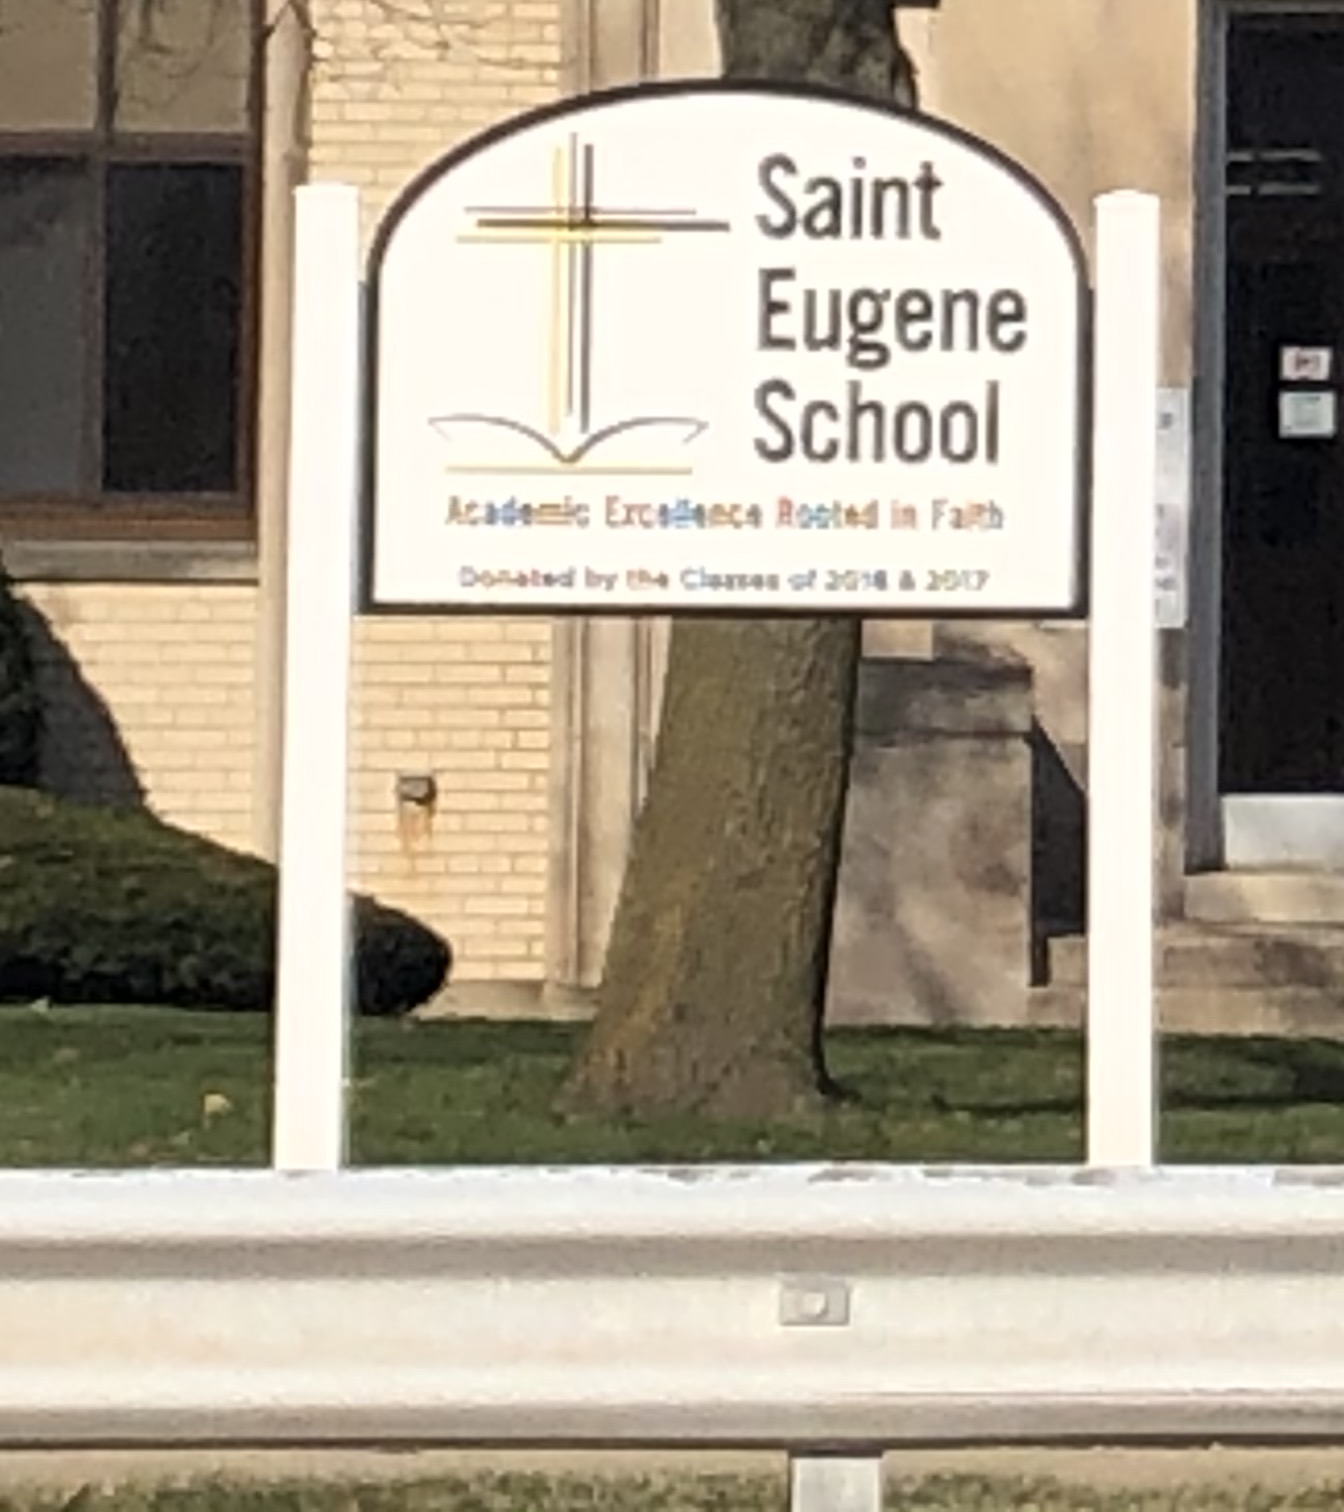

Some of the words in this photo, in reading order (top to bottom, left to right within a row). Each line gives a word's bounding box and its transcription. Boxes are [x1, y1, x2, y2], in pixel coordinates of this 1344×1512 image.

[756, 152, 944, 240] Saint
[756, 267, 1029, 371] Eugene
[753, 377, 1001, 464] School
[444, 494, 590, 529] Academic
[604, 495, 763, 529] Excellence
[775, 496, 879, 530] Rooted
[890, 498, 917, 530] in
[931, 498, 1005, 531] Faith
[459, 565, 577, 591] Donated
[583, 565, 618, 593] by
[625, 566, 670, 591] the
[679, 565, 780, 592] Classes
[786, 567, 817, 592] of
[924, 568, 990, 592] 2017
